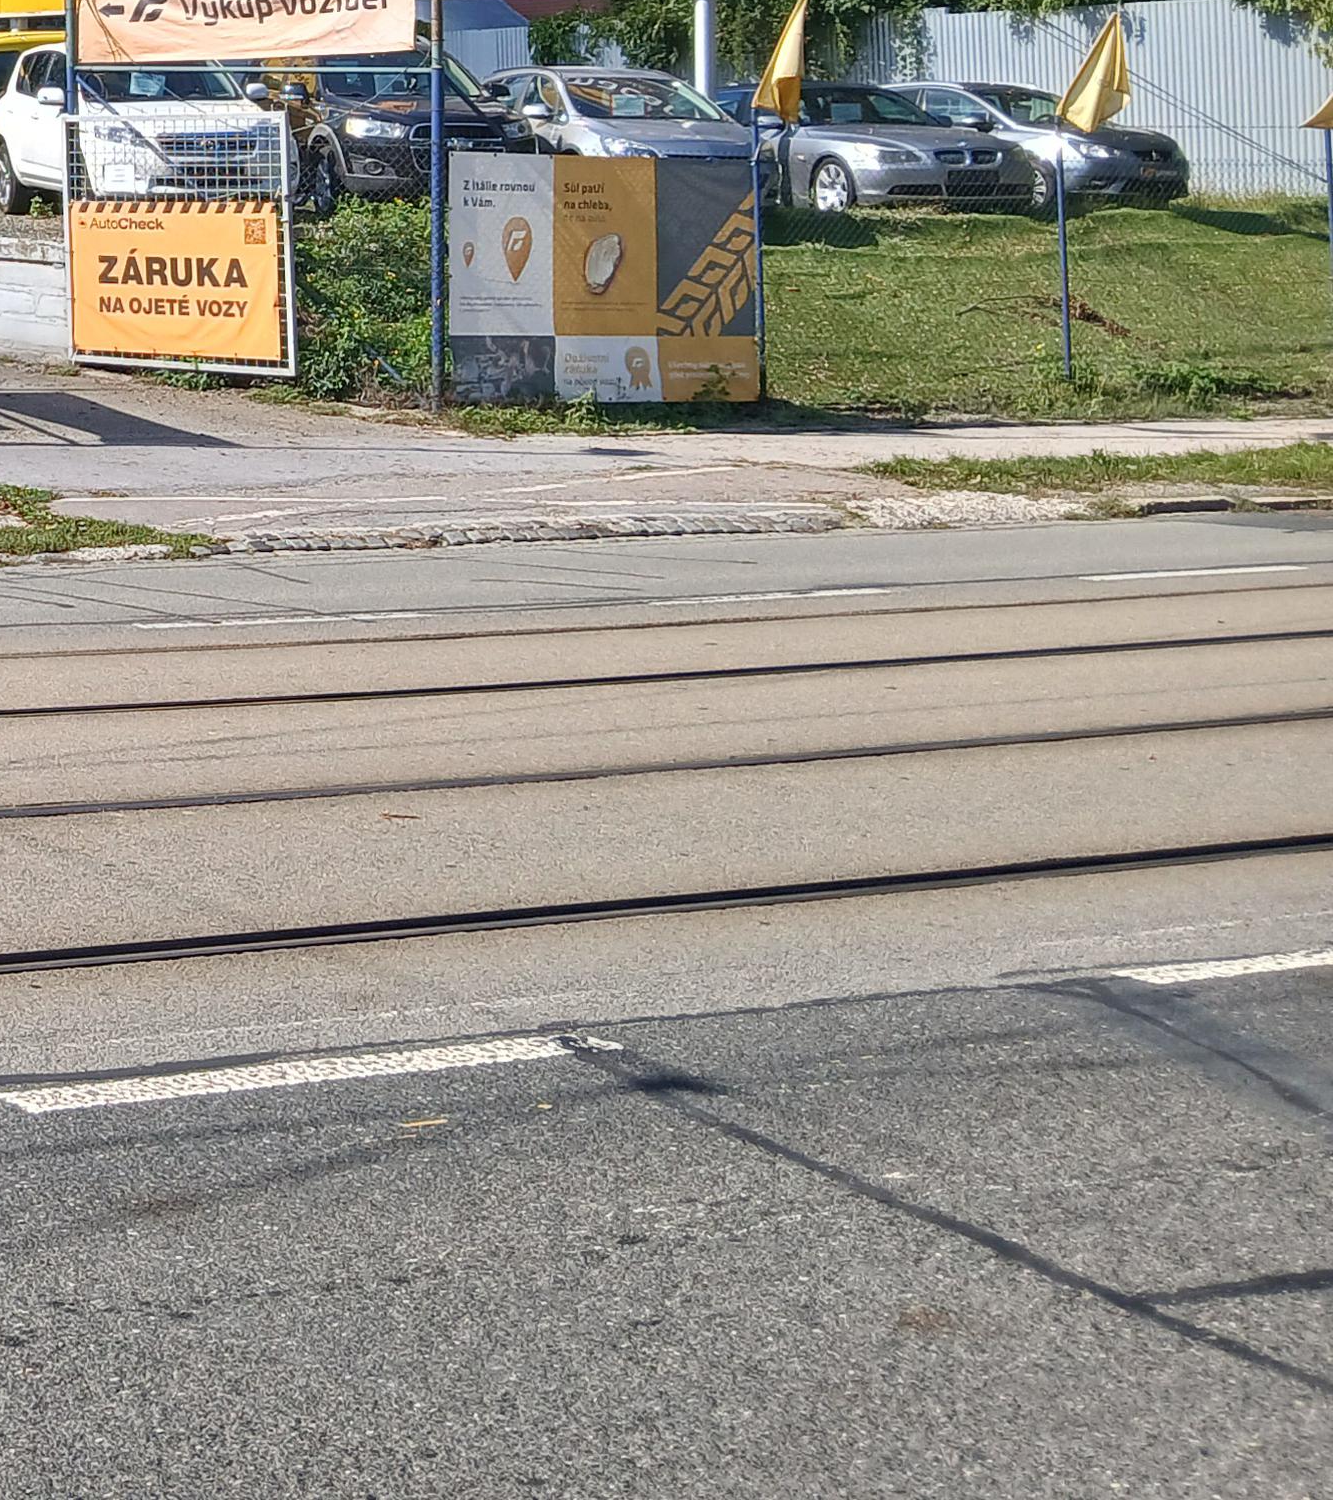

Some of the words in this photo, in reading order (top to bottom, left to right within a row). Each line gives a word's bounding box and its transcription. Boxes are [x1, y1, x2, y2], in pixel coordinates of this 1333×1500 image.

[463, 180, 470, 191] Z
[499, 181, 535, 192] rovnou
[463, 197, 469, 207] k
[471, 196, 496, 208] Vám.
[564, 202, 576, 210] na
[89, 217, 164, 230] AutoCheck
[98, 248, 248, 288] ZÁRUKA
[99, 296, 125, 314] NA
[129, 295, 190, 316] OJETÉ
[197, 300, 248, 318] VOZY
